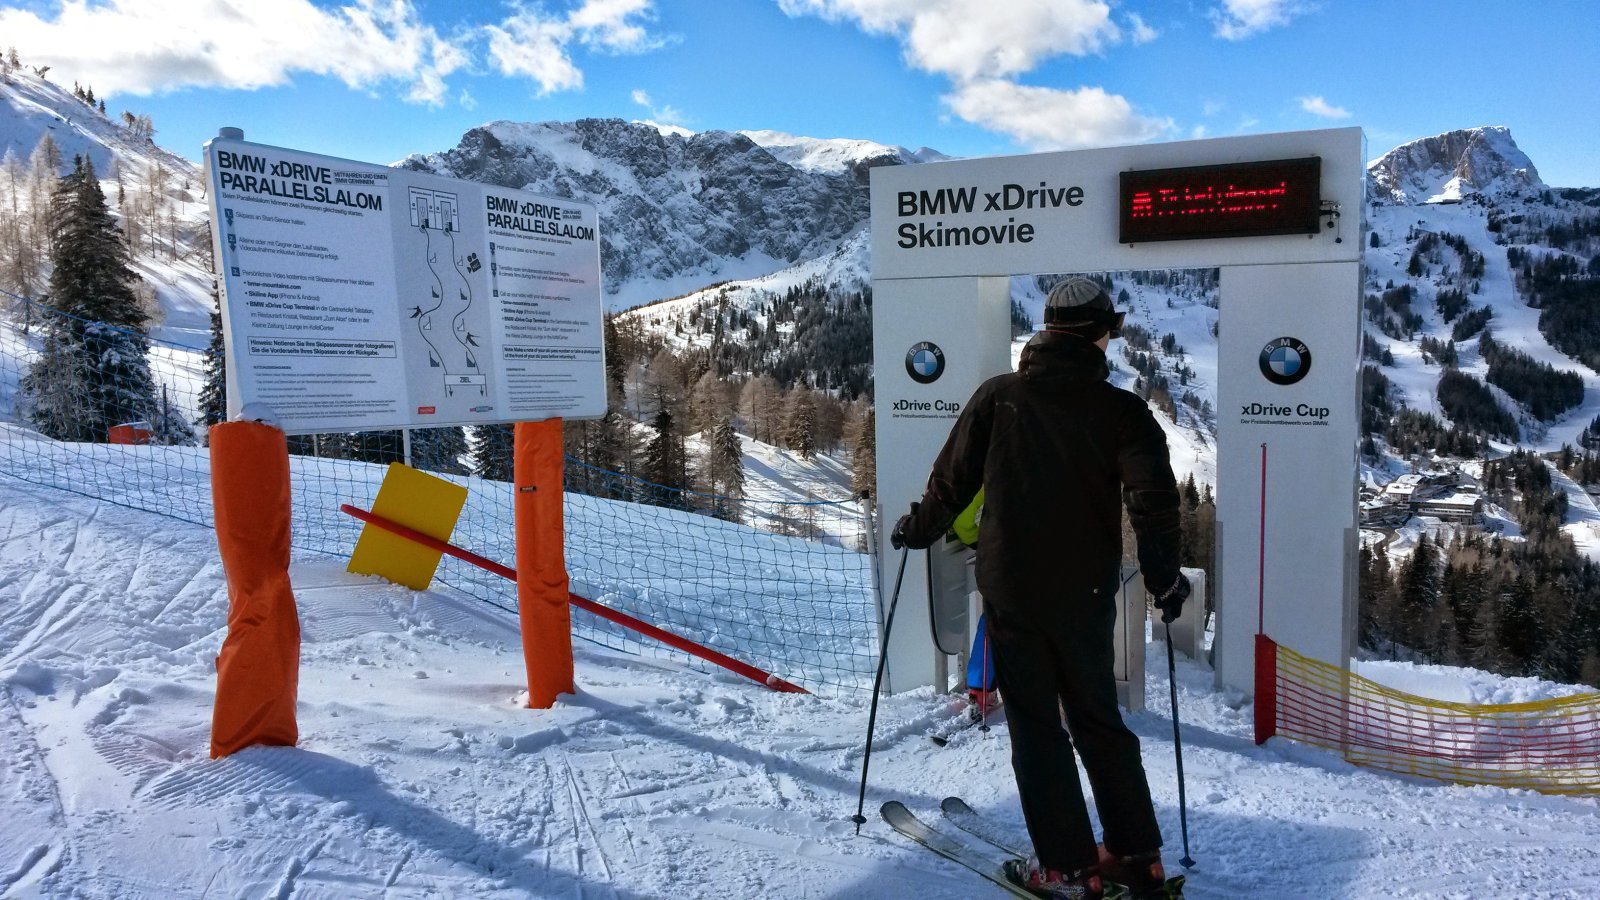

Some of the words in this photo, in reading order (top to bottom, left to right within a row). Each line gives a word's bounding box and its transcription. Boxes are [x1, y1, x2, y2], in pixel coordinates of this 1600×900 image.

[218, 150, 266, 174] BMW
[270, 161, 332, 185] xDRIVE
[220, 171, 382, 211] PARALLELSLALOM
[898, 187, 977, 217] BMW
[984, 182, 1084, 212] xDrive
[486, 195, 518, 213] BMW
[520, 202, 561, 221] xDRIVE
[487, 213, 594, 241] PARALLELSLALOM
[897, 217, 1034, 249] Skimovie
[910, 343, 941, 357] BMW
[1265, 339, 1307, 354] BMW
[893, 400, 931, 411] xDrive
[934, 400, 960, 413] Cup
[1242, 403, 1292, 416] xDrive
[1297, 404, 1330, 419] Cup
